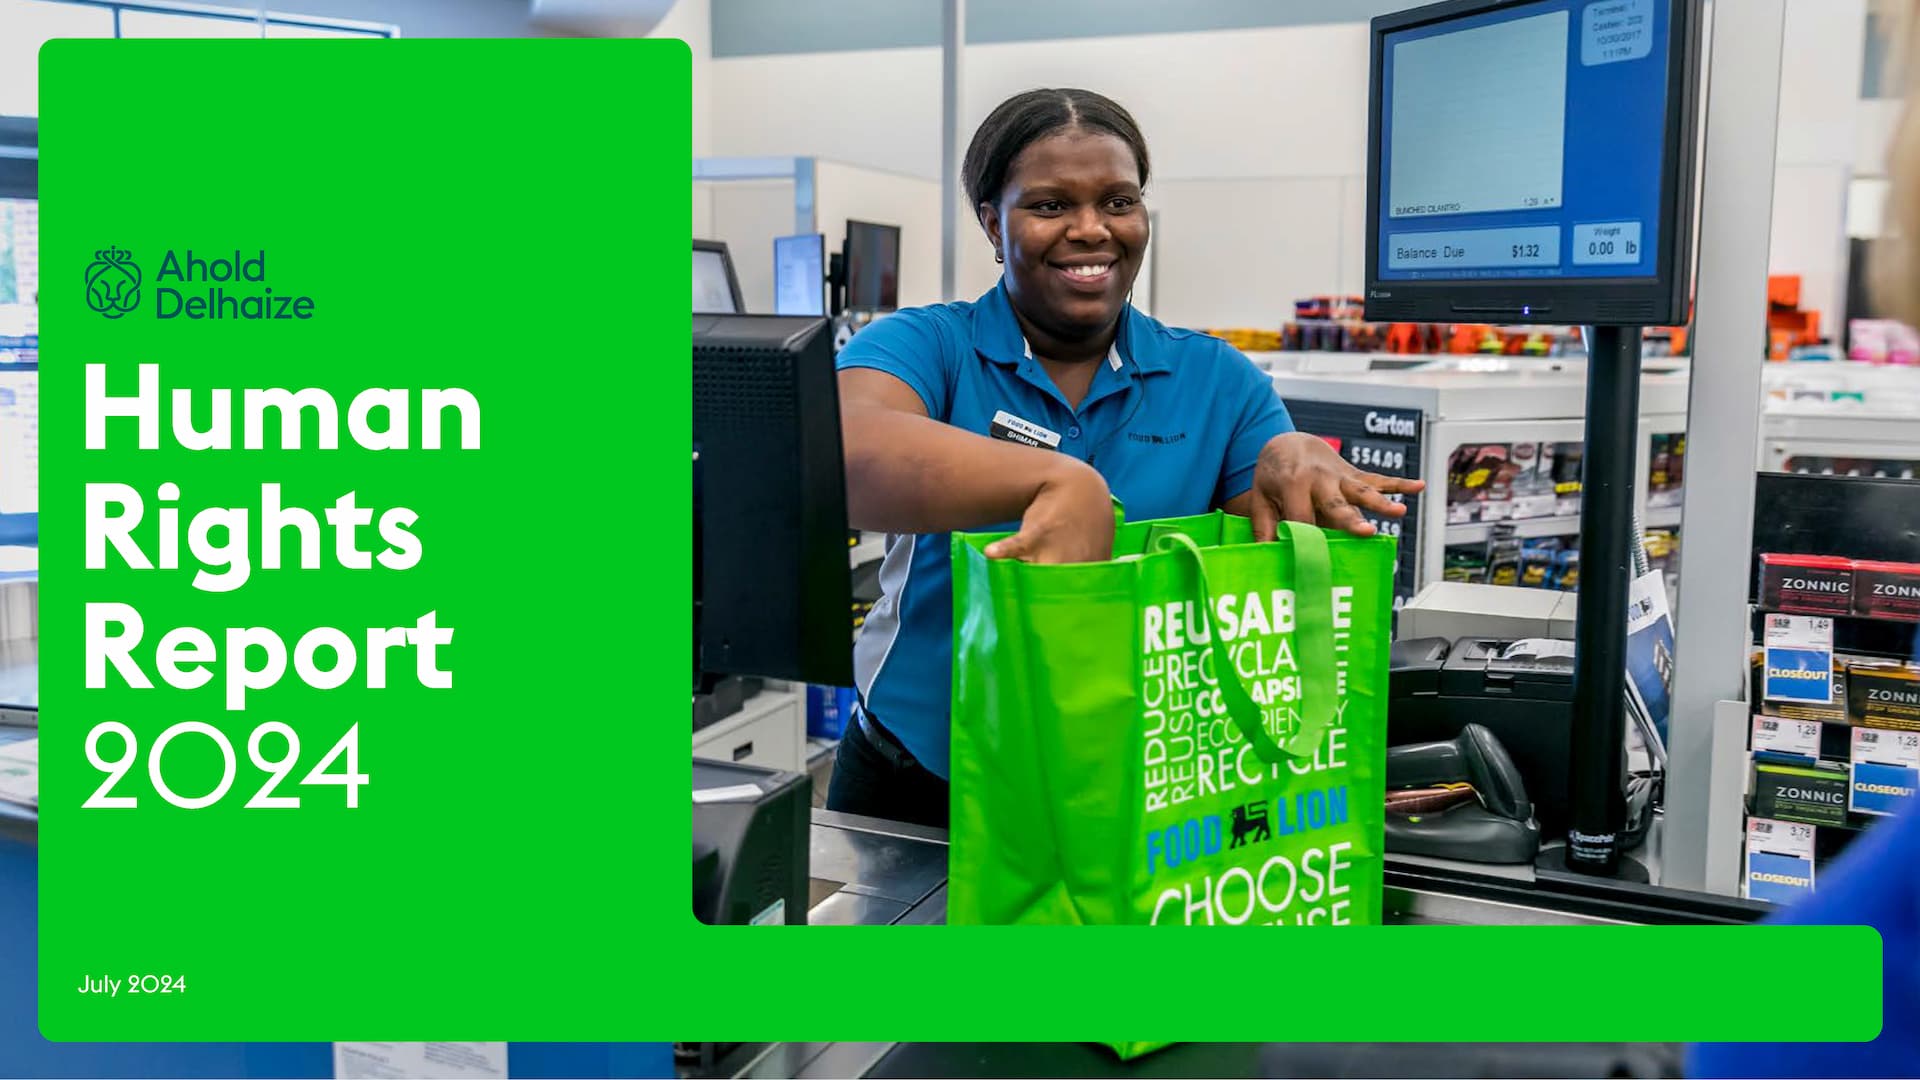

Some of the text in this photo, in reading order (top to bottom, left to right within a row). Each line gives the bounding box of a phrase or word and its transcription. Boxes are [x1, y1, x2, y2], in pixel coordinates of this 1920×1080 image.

[1397, 241, 1638, 260] Balance Due $1.32 0.00 lb
[1364, 411, 1415, 437] Carton
[1006, 430, 1039, 448] SHIMAR
[1782, 577, 1850, 593] ZONNIC
[1144, 586, 1353, 654] REUSABE
[1808, 618, 1829, 631] 1.49
[1768, 667, 1829, 682] CLOSEOUT
[1143, 656, 1168, 813] REDUCE
[1797, 723, 1817, 737] 1.28
[1169, 691, 1195, 805] REUSE
[1897, 735, 1919, 748] 1.28
[1776, 786, 1844, 804] ZONNIC
[1854, 781, 1914, 798] CLOSEOUT
[1146, 786, 1348, 875] FOOD LION
[1750, 870, 1810, 889] CLOSEOUT
